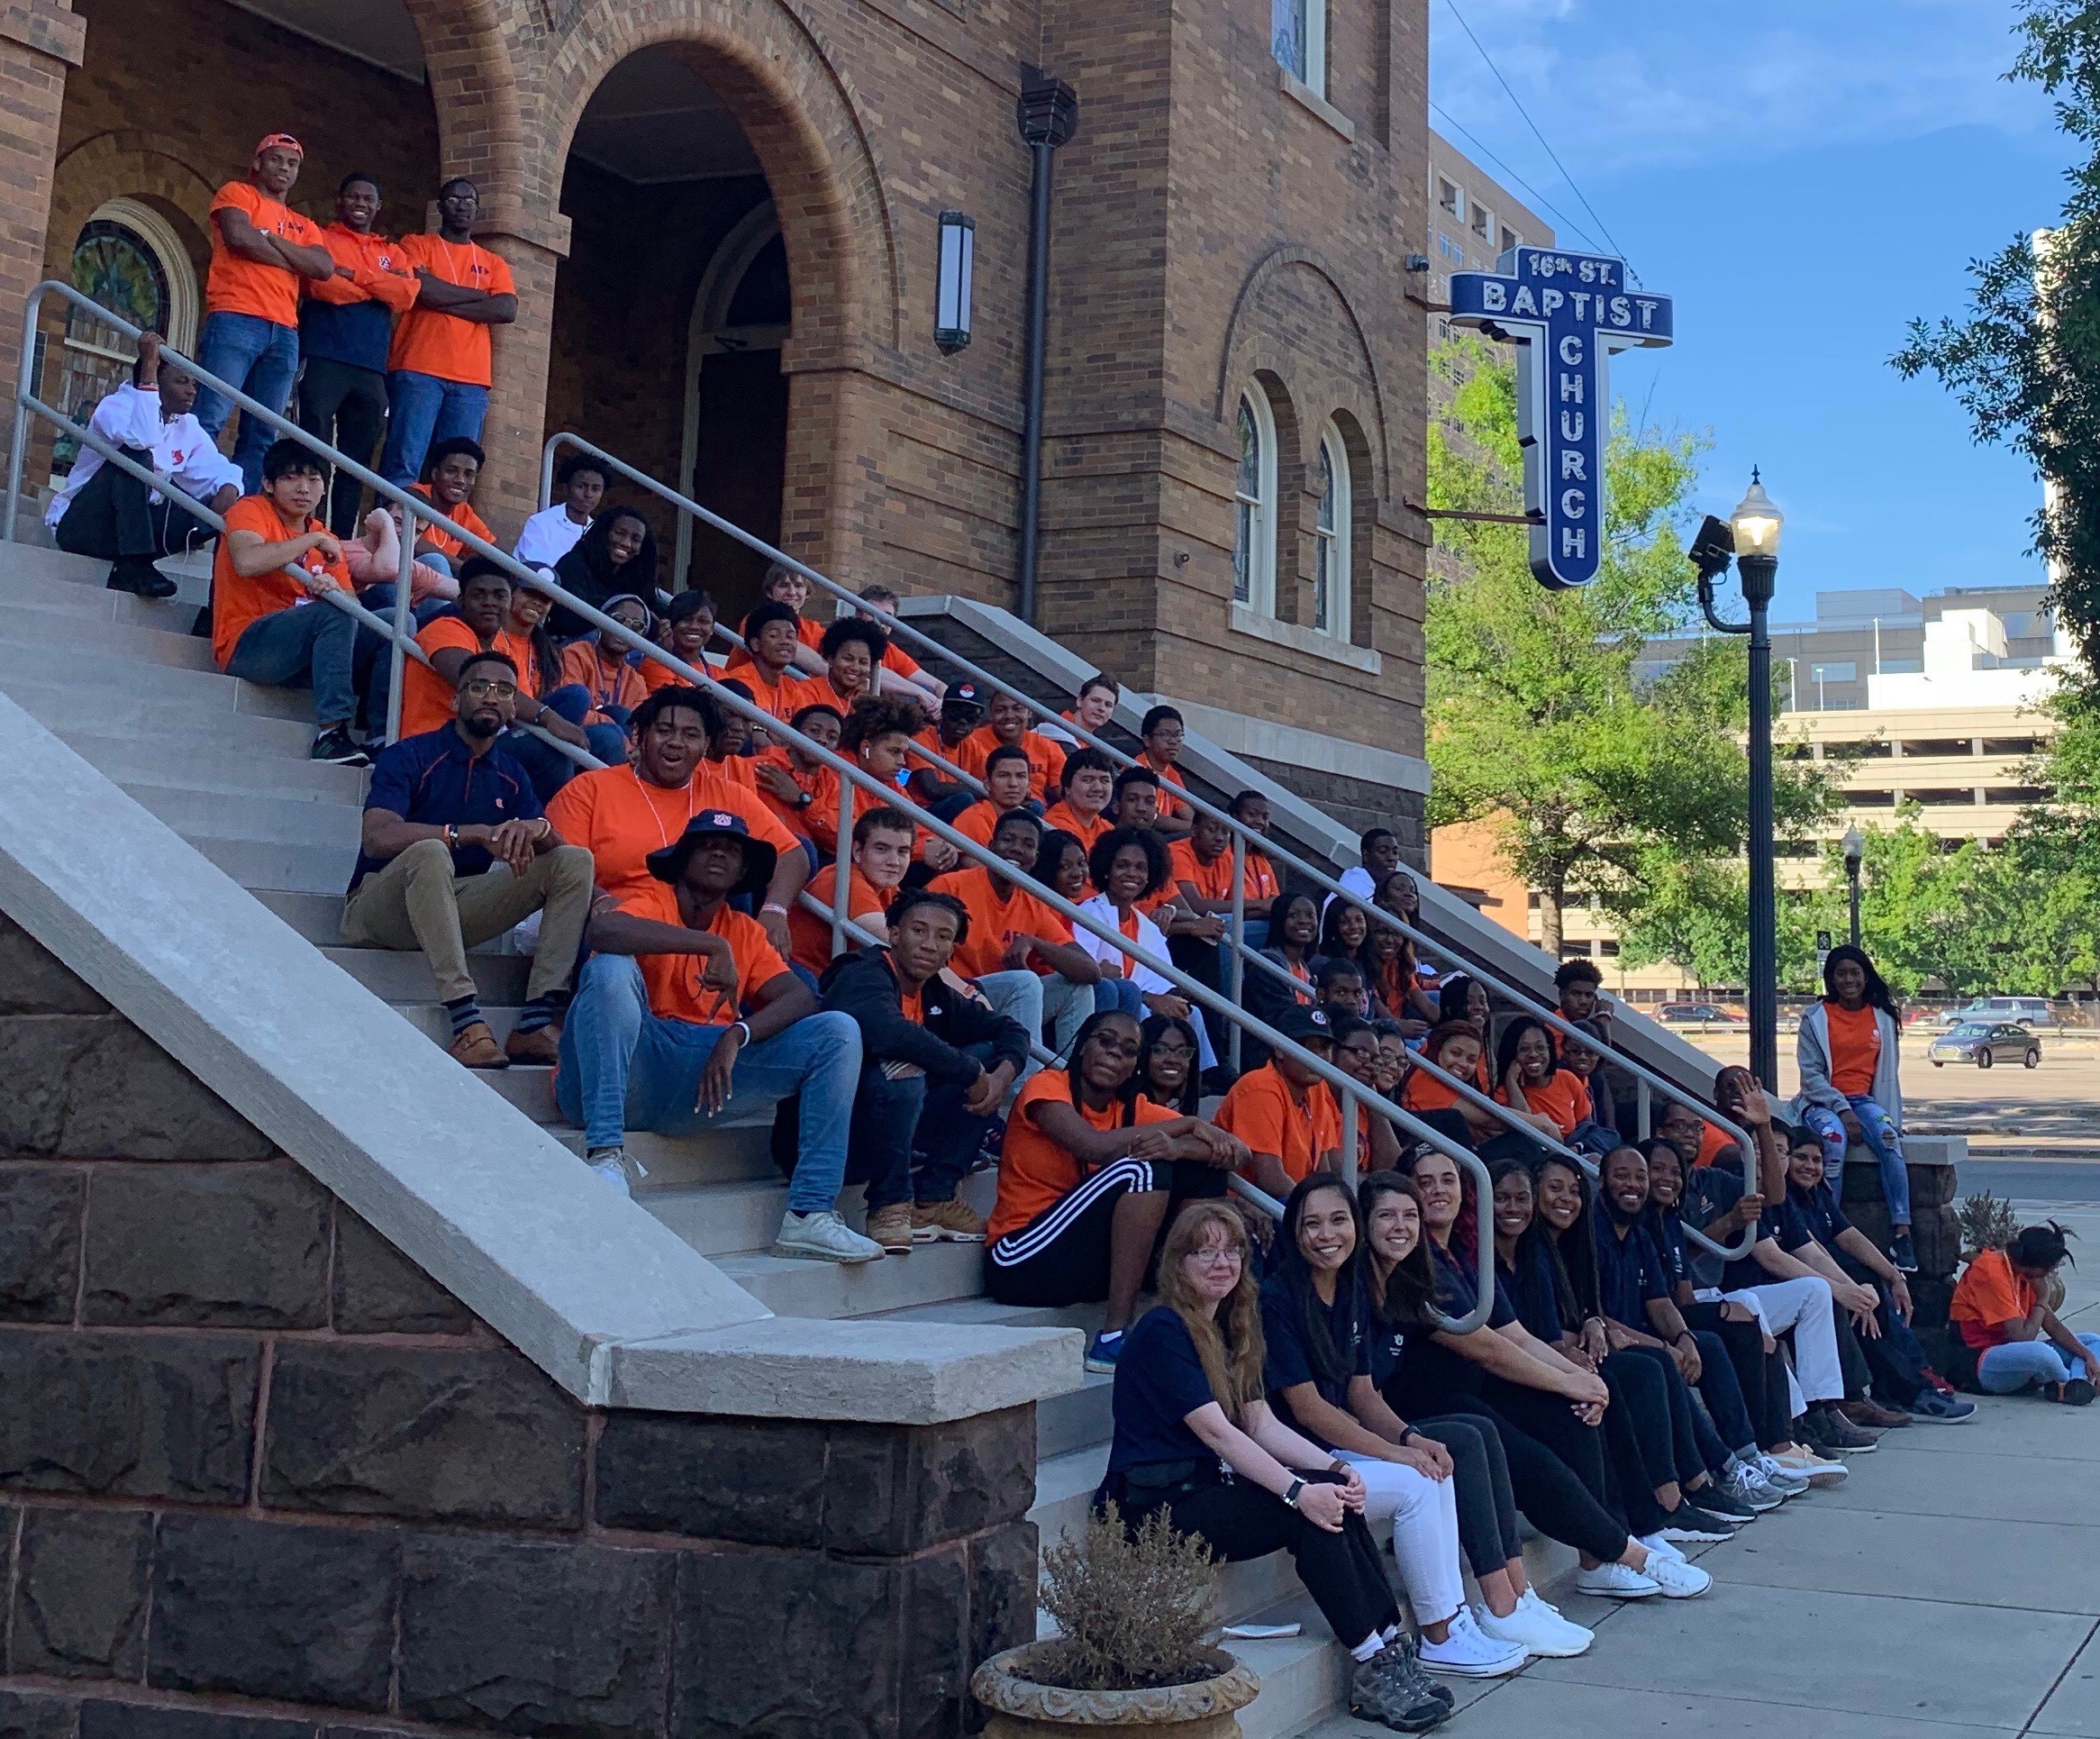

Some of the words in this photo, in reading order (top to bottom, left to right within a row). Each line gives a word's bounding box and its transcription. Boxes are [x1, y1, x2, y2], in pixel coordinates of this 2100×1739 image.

[1578, 260, 1617, 286] ST.
[1482, 280, 1659, 330] BAPTIST
[1559, 334, 1586, 560] CHURCH
